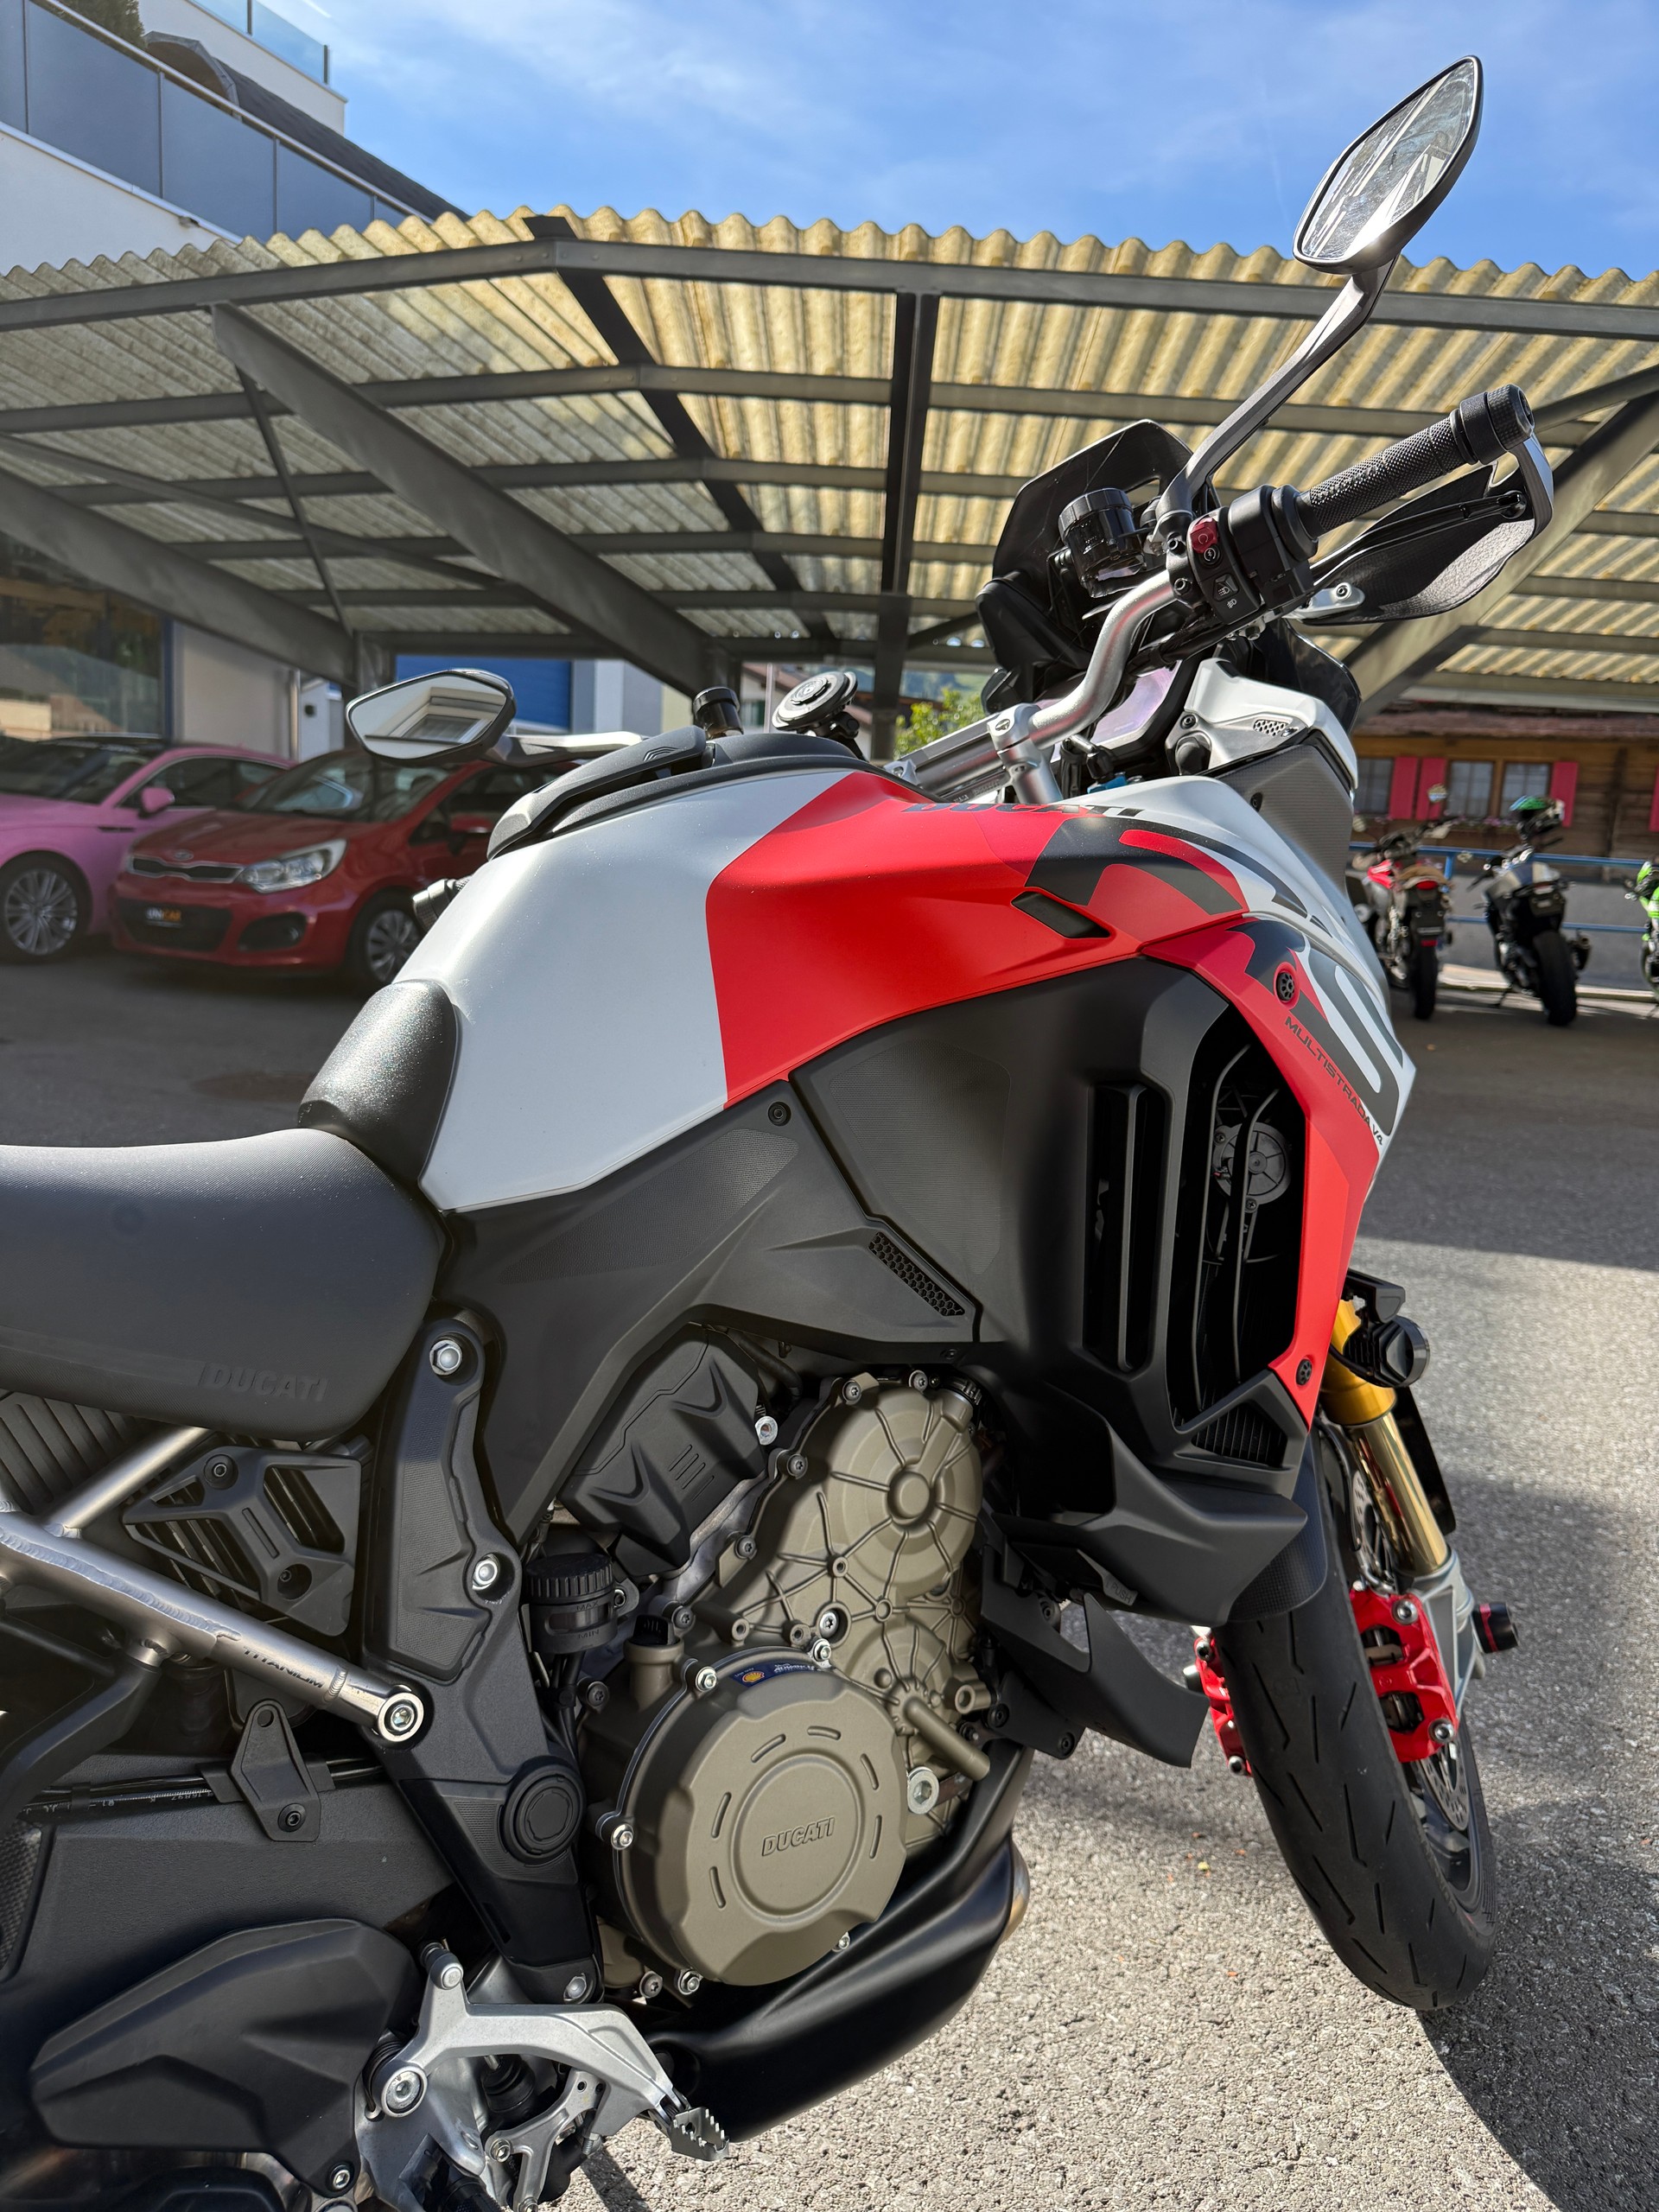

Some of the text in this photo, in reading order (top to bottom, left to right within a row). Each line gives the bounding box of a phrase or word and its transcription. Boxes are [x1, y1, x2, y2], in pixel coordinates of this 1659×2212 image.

[1284, 1016, 1383, 1146] MULTISTRADA V4
[198, 1362, 328, 1402] DUCATI
[576, 1600, 599, 1611] MAX
[578, 1629, 600, 1639] MIN
[244, 1646, 325, 1688] TITANIUM
[761, 1815, 835, 1857] DUCATI
